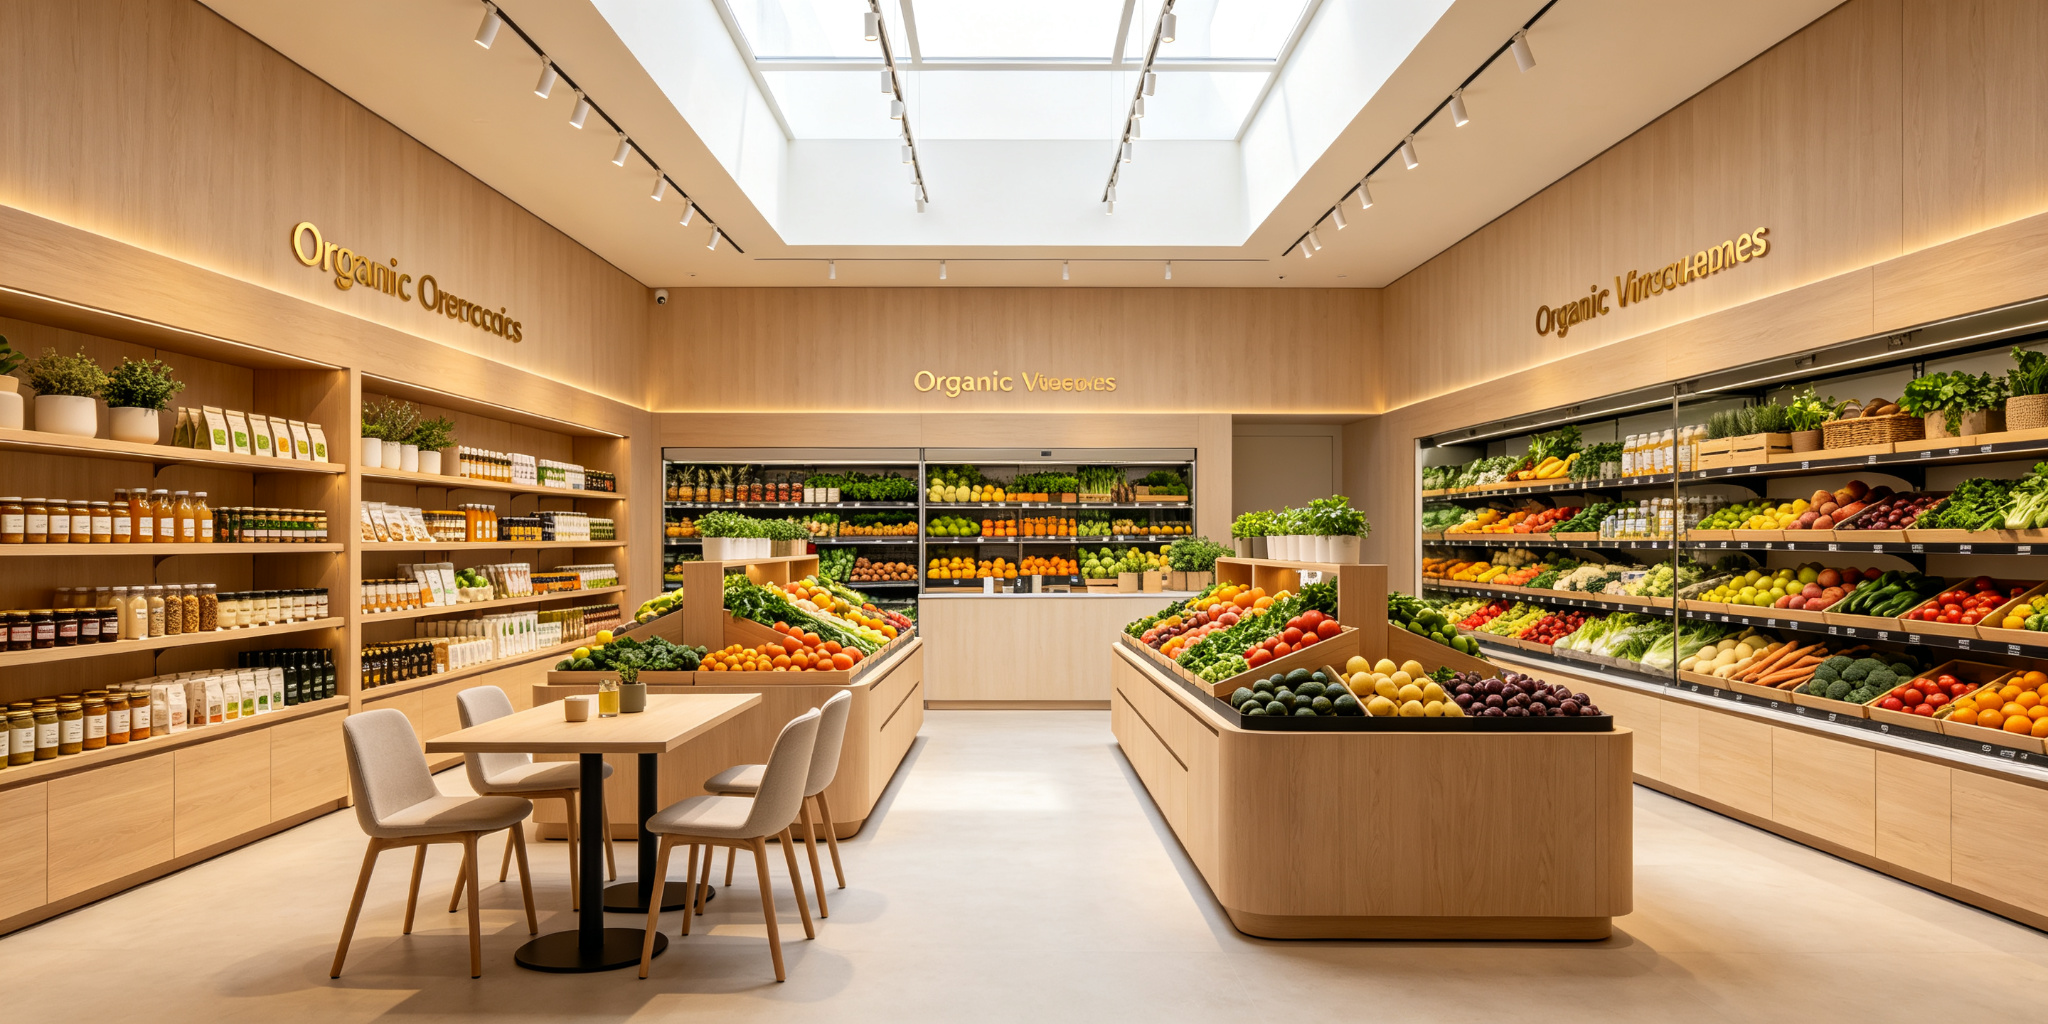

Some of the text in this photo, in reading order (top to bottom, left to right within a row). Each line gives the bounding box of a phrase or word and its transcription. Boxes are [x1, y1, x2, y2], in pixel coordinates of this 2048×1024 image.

[291, 221, 412, 302] Organic
[1535, 284, 1610, 339] Organic
[913, 370, 1014, 398] Organic
